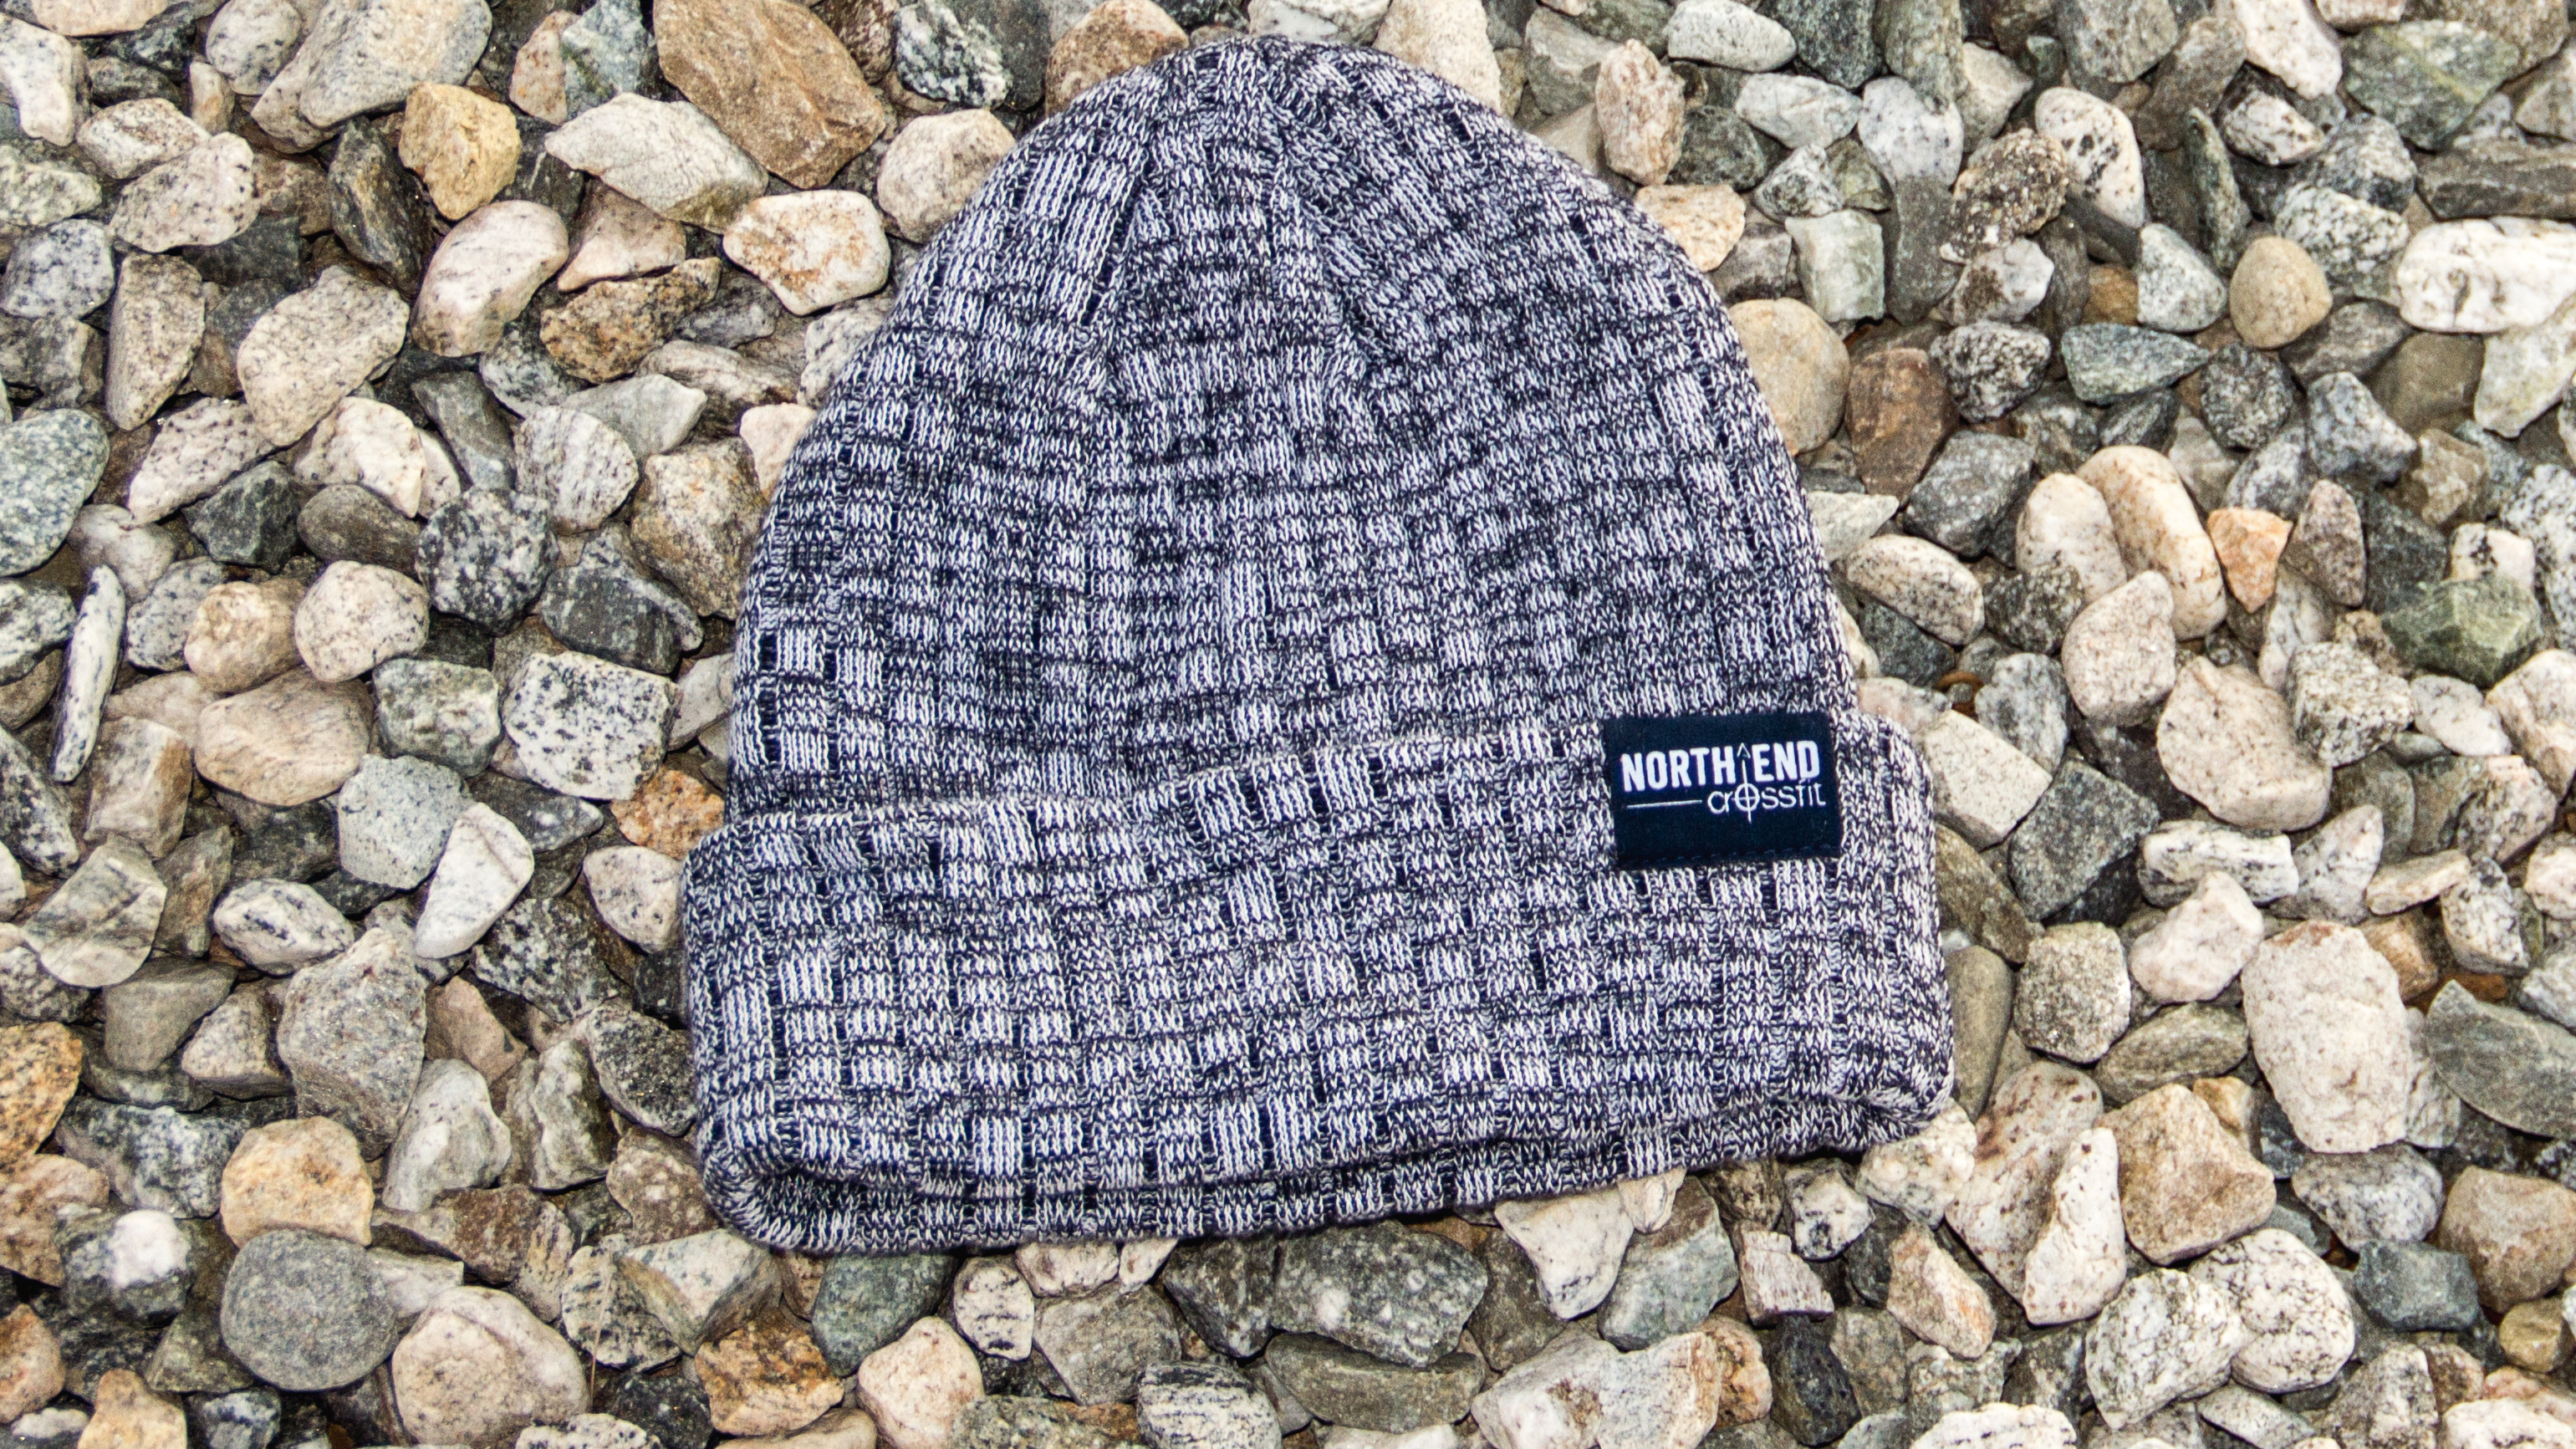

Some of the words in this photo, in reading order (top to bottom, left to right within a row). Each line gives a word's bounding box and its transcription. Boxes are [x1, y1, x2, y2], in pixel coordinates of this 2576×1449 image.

[1620, 746, 1737, 793] NORTH
[1752, 740, 1820, 783] END
[1707, 778, 1826, 814] crossfit
